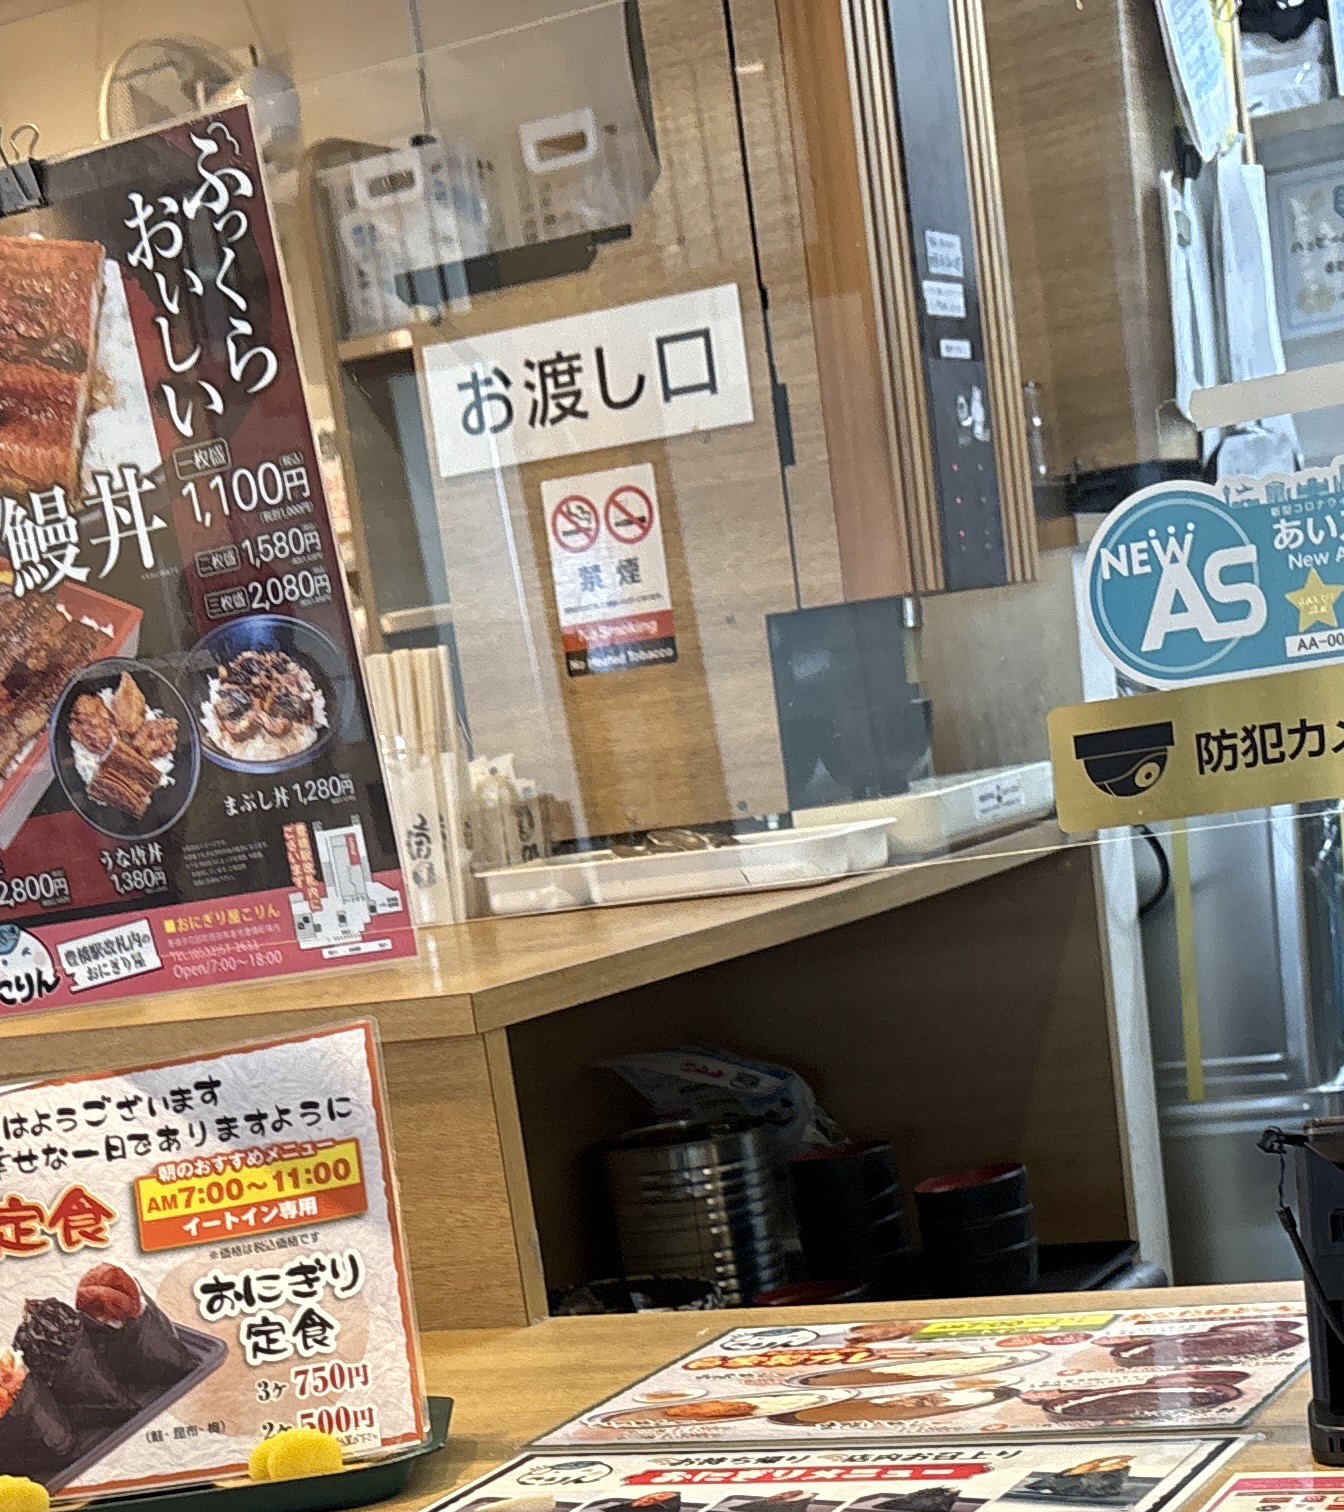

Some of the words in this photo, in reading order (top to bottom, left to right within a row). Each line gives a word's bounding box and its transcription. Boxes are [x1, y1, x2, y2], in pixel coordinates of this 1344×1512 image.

[182, 130, 279, 394] ふっくら
[123, 191, 226, 438] おいしい
[457, 328, 720, 437] お渡し口
[181, 461, 311, 528] 1,100円
[0, 466, 168, 597] 鰻丼
[241, 527, 322, 569] 1,580円
[1099, 530, 1196, 580] NEW
[1288, 551, 1329, 570] New
[248, 570, 332, 611] 2,080円
[1140, 543, 1268, 653] AS
[292, 774, 356, 805] 1,280円
[157, 1138, 335, 1183] 朝のおすすめメニュー
[183, 1197, 319, 1237] イートイン専用
[201, 1253, 361, 1315] おにぎり
[246, 1307, 335, 1359] 定食
[293, 1361, 370, 1400] 750円
[650, 1466, 957, 1484] おにぎりメニュー
